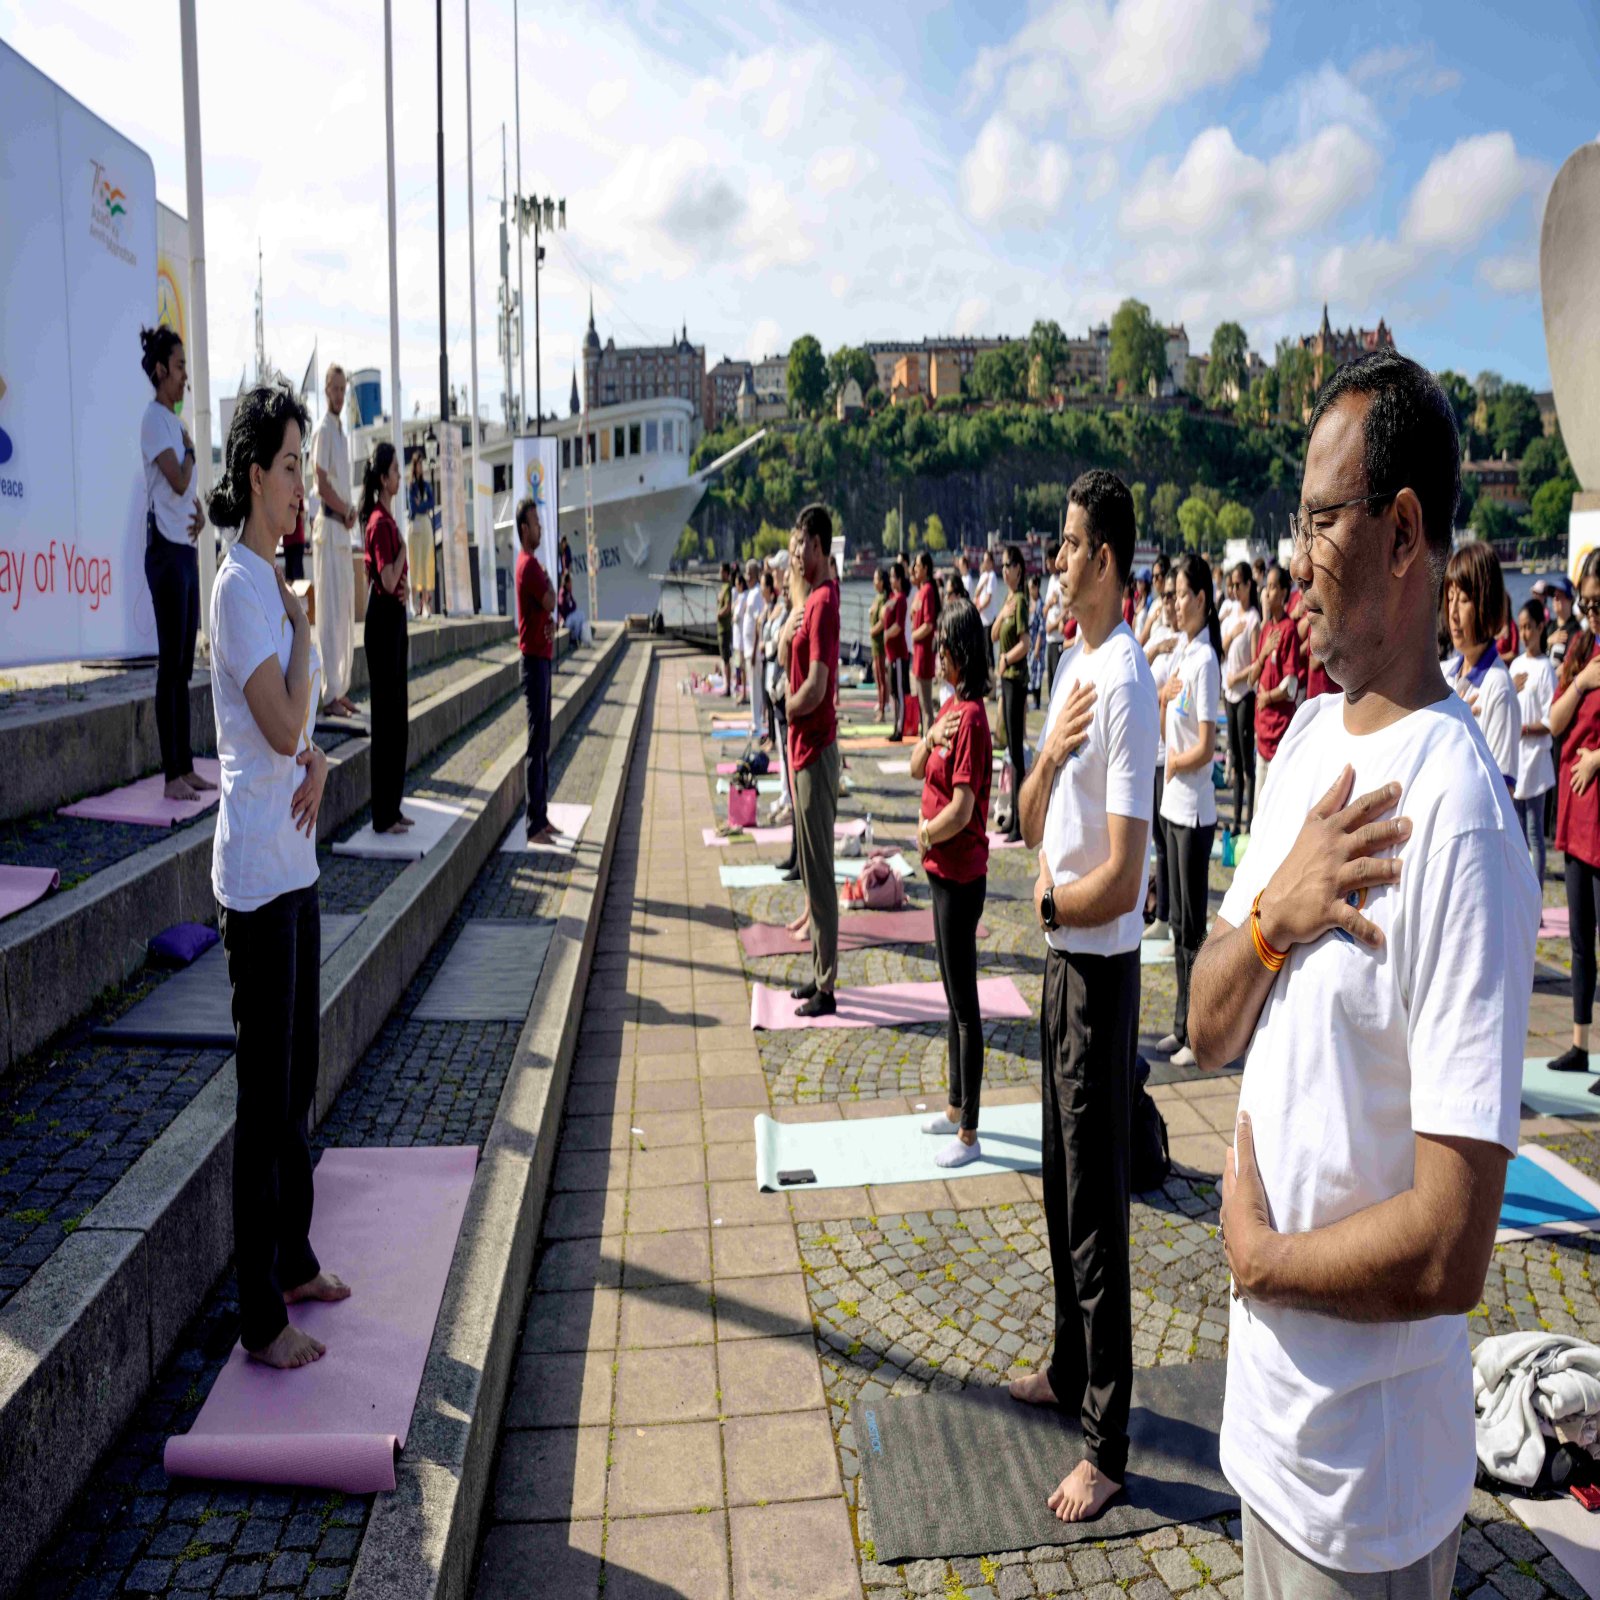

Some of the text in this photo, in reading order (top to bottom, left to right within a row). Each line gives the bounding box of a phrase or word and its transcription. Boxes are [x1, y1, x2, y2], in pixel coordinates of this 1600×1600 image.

[0, 477, 24, 498] eace
[0, 538, 111, 611] ay of Yoga
